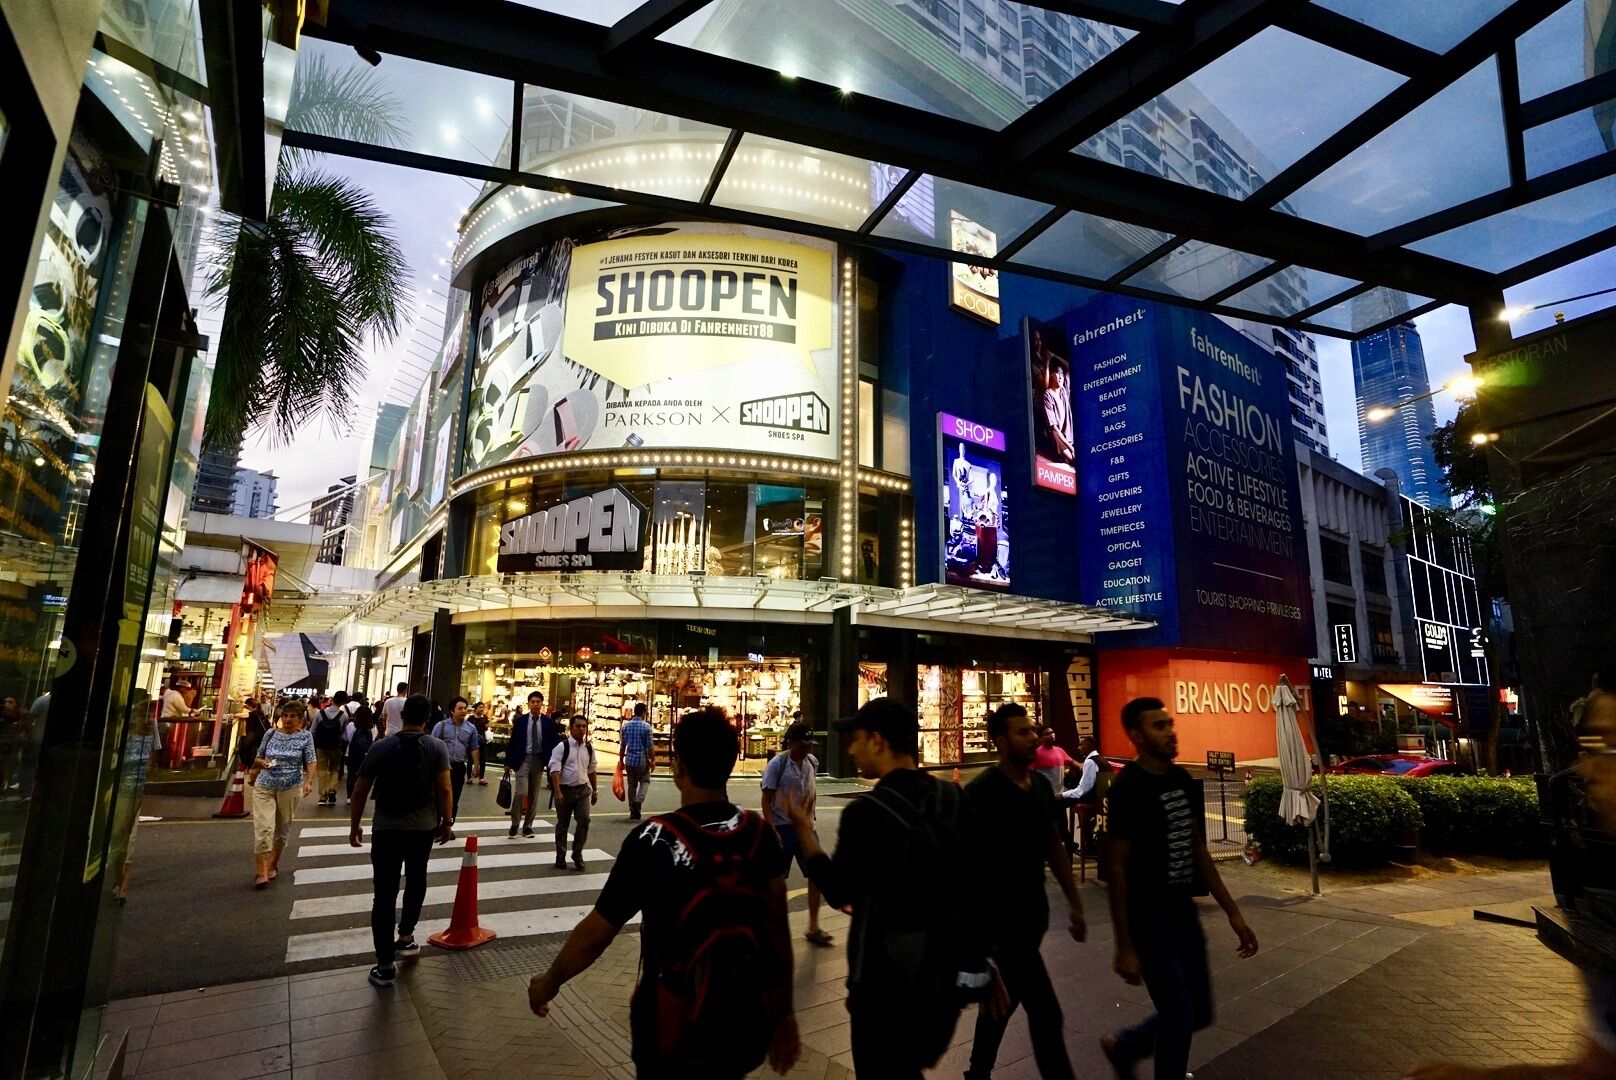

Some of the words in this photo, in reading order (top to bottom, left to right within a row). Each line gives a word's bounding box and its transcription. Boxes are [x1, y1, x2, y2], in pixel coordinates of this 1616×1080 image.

[608, 254, 633, 264] JENAMA
[634, 252, 659, 263] FESYEN
[660, 251, 681, 260] KASUT
[682, 250, 696, 259] DAN
[698, 250, 731, 261] AKSESORI
[732, 253, 759, 263] TERKINI
[760, 255, 776, 265] DARI
[777, 257, 798, 269] KOREA
[595, 269, 798, 320] SHOOPEN
[957, 289, 999, 317] FOOD
[1093, 353, 1127, 371] FASHION
[1477, 334, 1568, 373] RESTORAN
[1083, 364, 1142, 391] ENTERTAINMENT
[1099, 387, 1127, 402] BEAUTY
[606, 401, 632, 409] DIBAWA
[634, 400, 661, 408] KEPADA
[685, 400, 702, 408] OLEH
[742, 394, 829, 433] SHOOPEN
[1101, 404, 1127, 417] SHOES
[1177, 365, 1283, 455] FASHION
[604, 412, 702, 428] PARKSON
[1104, 421, 1126, 434] BAGS
[768, 430, 790, 439] SHOES
[791, 432, 805, 441] SPA
[955, 418, 994, 444] SHOP
[1090, 433, 1144, 454] ACCESSORIES
[1184, 416, 1286, 485] ACCESSORIES
[1110, 455, 1125, 466] F&B
[1038, 467, 1075, 489] PAMPER
[1108, 471, 1130, 483] GIFTS
[1187, 455, 1234, 491] ACTIVE
[1237, 469, 1289, 511] LIFESTYLE
[1098, 485, 1143, 502] SOUVENIRS
[1100, 503, 1142, 519] JEWELLERY
[1187, 479, 1223, 510] FOOD
[1226, 496, 1236, 514] &
[1237, 498, 1292, 533] BEVERAGES
[499, 487, 641, 555] SHOOPEN
[1100, 521, 1145, 536] TIMEPIECES
[1190, 505, 1295, 558] ENTERTAINMENT
[1107, 540, 1141, 553] OPTICAL
[535, 554, 569, 568] SHOES
[571, 554, 593, 567] SPA
[1108, 557, 1143, 570] GADGET
[1103, 575, 1150, 589] EDUCATION
[1095, 596, 1123, 607] ACTIVE
[1125, 592, 1162, 604] LIFESTYLE
[1196, 588, 1227, 606] TOURIST
[1228, 593, 1266, 613] SHOPPING
[1267, 600, 1301, 620] PRIVILEGES
[1340, 626, 1349, 661] CHAOS
[1175, 681, 1252, 715] BRANDS
